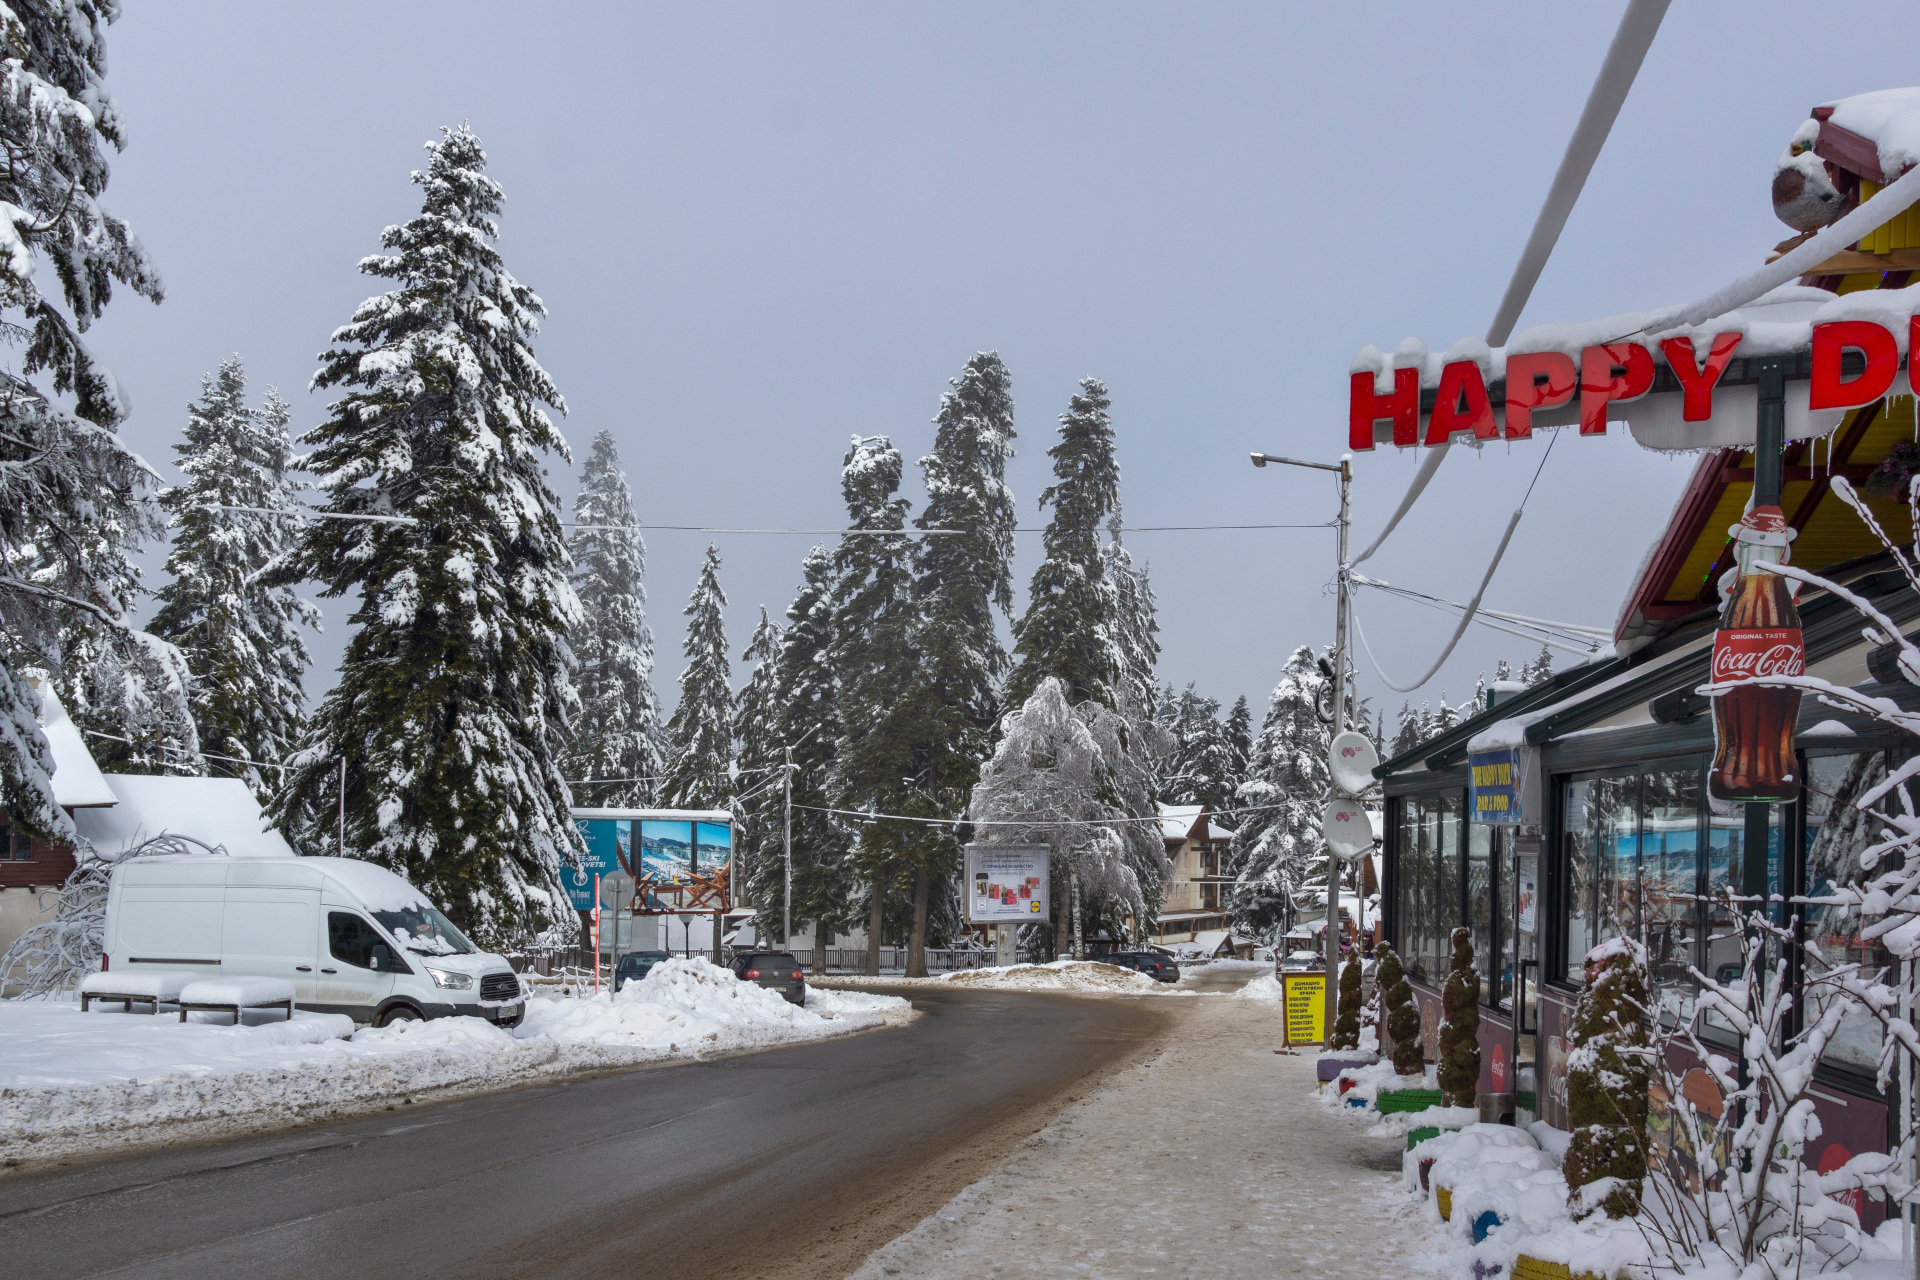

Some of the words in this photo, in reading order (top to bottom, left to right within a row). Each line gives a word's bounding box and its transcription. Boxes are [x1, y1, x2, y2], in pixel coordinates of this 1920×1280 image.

[1349, 332, 1743, 452] HAPPY
[1809, 314, 1920, 412] D
[1765, 632, 1787, 640] TASTE
[1714, 644, 1802, 677] Coca-Cola
[1472, 766, 1482, 786] THE
[1482, 765, 1498, 786] HAPPY
[1498, 763, 1511, 785] DUCK
[1477, 796, 1489, 811] BAR
[1494, 795, 1508, 811] FOOD
